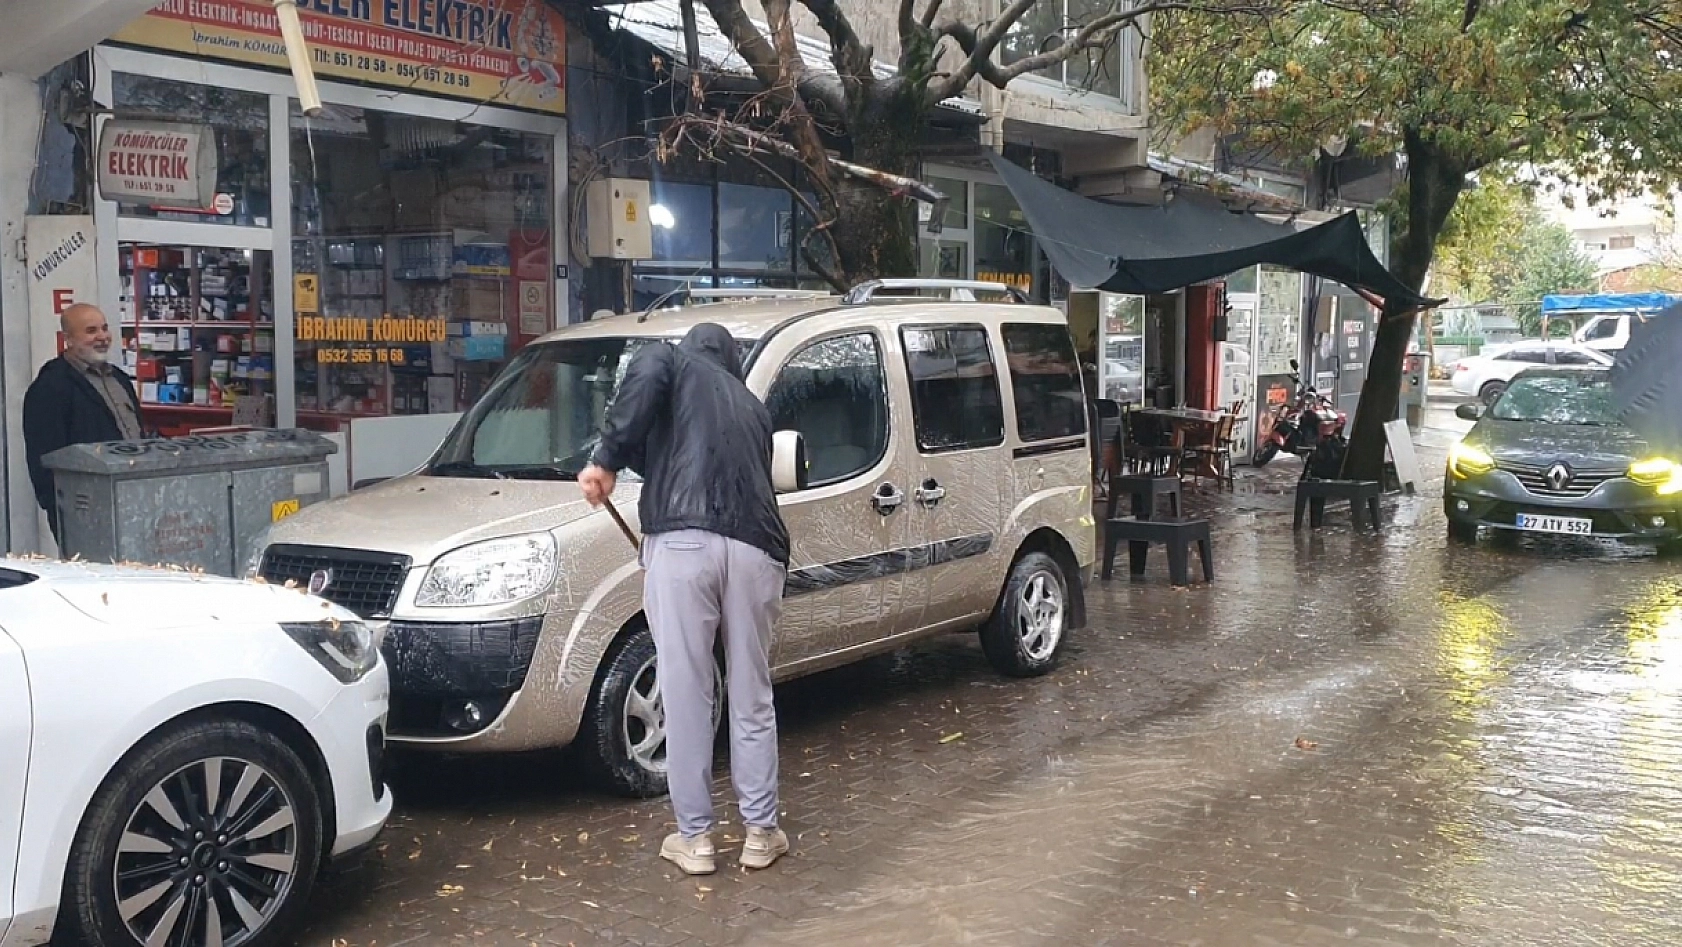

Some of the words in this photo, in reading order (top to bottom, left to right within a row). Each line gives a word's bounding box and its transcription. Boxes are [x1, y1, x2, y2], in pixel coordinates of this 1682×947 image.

[383, 0, 512, 49] ELEKTRİK
[243, 38, 287, 56] KÖMÜR
[334, 53, 353, 67] 651
[358, 56, 370, 70] 28
[373, 59, 387, 73] 58
[444, 72, 455, 85] 28
[458, 74, 470, 87] 58
[398, 38, 424, 57] PROJE
[113, 130, 188, 152] KÖMÜRCÜLER
[108, 151, 189, 181] ELEKTRİK
[32, 231, 87, 282] KÖMÜRCÜLER
[297, 313, 367, 340] İBRAHİM
[372, 312, 446, 342] KÖMÜRCÜ
[317, 348, 348, 363] 0532
[351, 348, 372, 363] 565
[376, 348, 388, 363] 16
[1524, 517, 1538, 528] 27
[1542, 519, 1563, 531] ATV
[1567, 521, 1589, 533] 552
